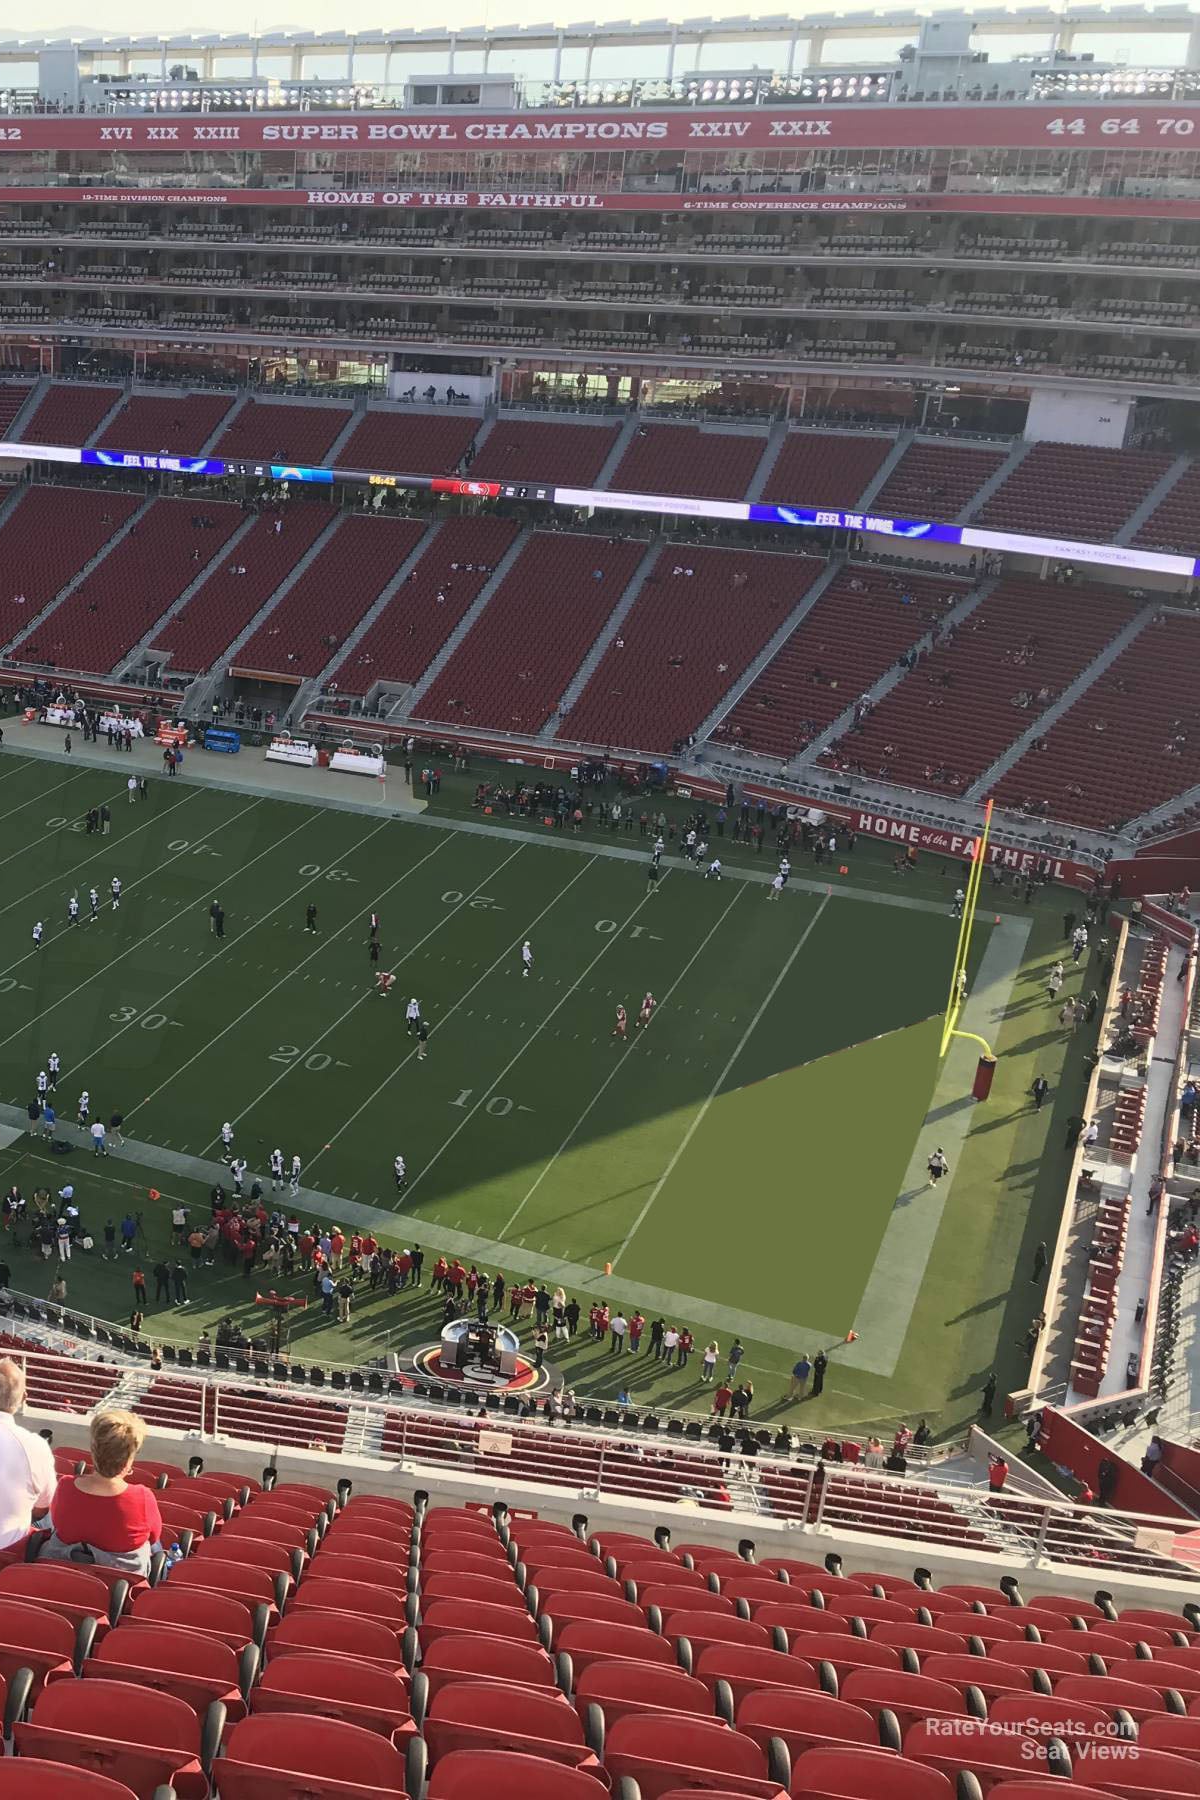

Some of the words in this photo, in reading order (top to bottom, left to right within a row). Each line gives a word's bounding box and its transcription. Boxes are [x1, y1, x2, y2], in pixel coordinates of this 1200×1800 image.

[100, 127, 133, 140] XVI
[146, 127, 179, 140] XIX
[193, 126, 240, 140] XXIII
[262, 124, 359, 140] SUPER
[367, 124, 457, 140] BOWL
[464, 122, 669, 140] CHAMPIONS
[688, 122, 751, 137] XXIV
[768, 120, 833, 137] XXIX
[1046, 118, 1086, 135] 44
[1100, 118, 1140, 135] 64
[1156, 119, 1195, 135] 70
[120, 194, 166, 202] DIVISION
[167, 195, 228, 203] CHAMPIONS
[307, 190, 375, 204] HOME
[382, 192, 413, 205] OF
[419, 192, 468, 206] THE
[477, 192, 604, 207] FAITHFUL
[683, 201, 729, 209] 6-TIME
[731, 201, 819, 210] CONFERENCE
[821, 201, 907, 210] CHAMPIONS
[124, 455, 141, 467] FEEL
[143, 456, 158, 468] THE
[816, 511, 841, 526] FEEL
[844, 514, 863, 529] THE
[859, 813, 921, 843] HOME
[441, 890, 496, 910] 20
[108, 1005, 168, 1031] 30
[268, 1044, 332, 1071] 20
[447, 1088, 513, 1116] 10
